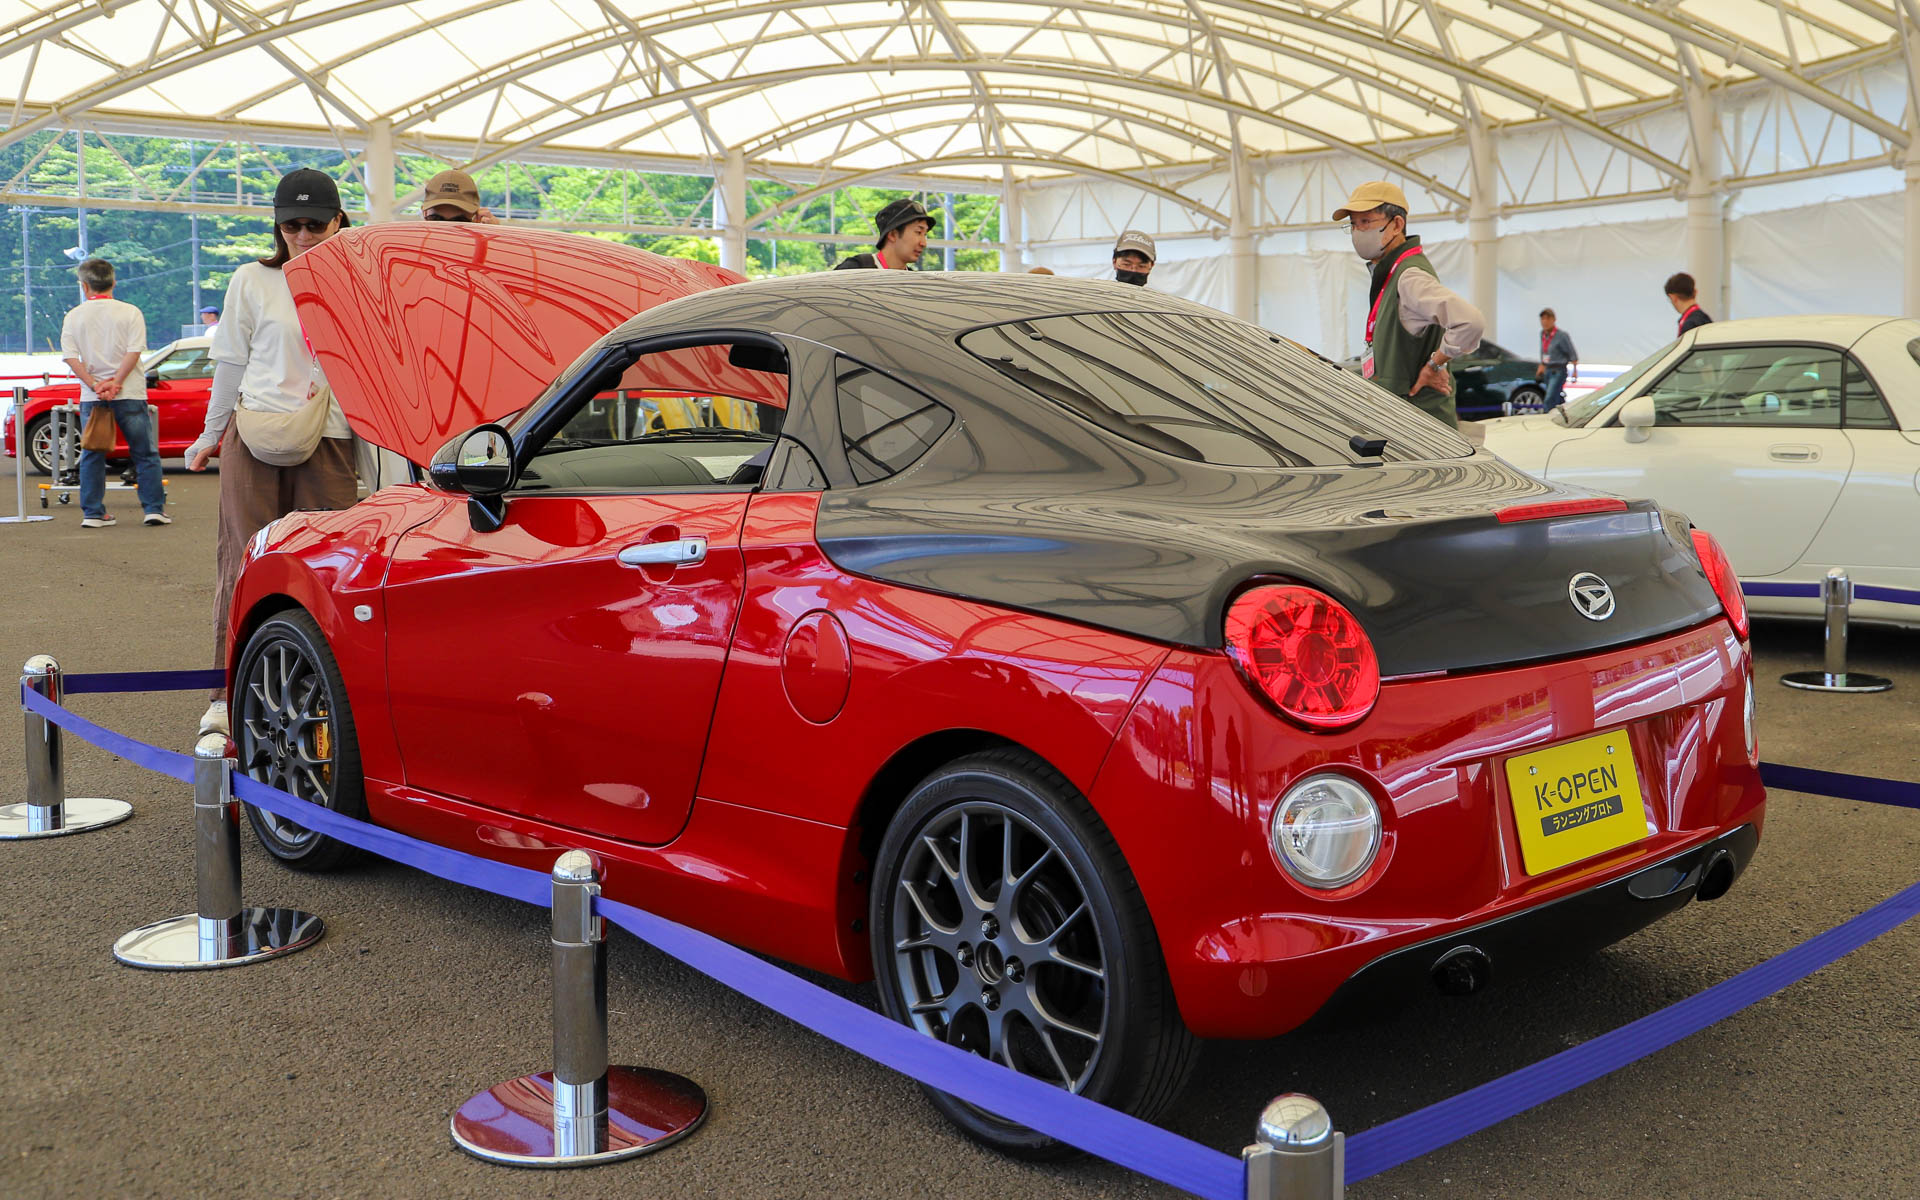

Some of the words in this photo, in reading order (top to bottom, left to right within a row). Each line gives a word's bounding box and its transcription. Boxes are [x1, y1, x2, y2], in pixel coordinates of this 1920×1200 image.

[1534, 763, 1618, 811] K-OPEN
[1552, 800, 1613, 831] ランニングプロト
